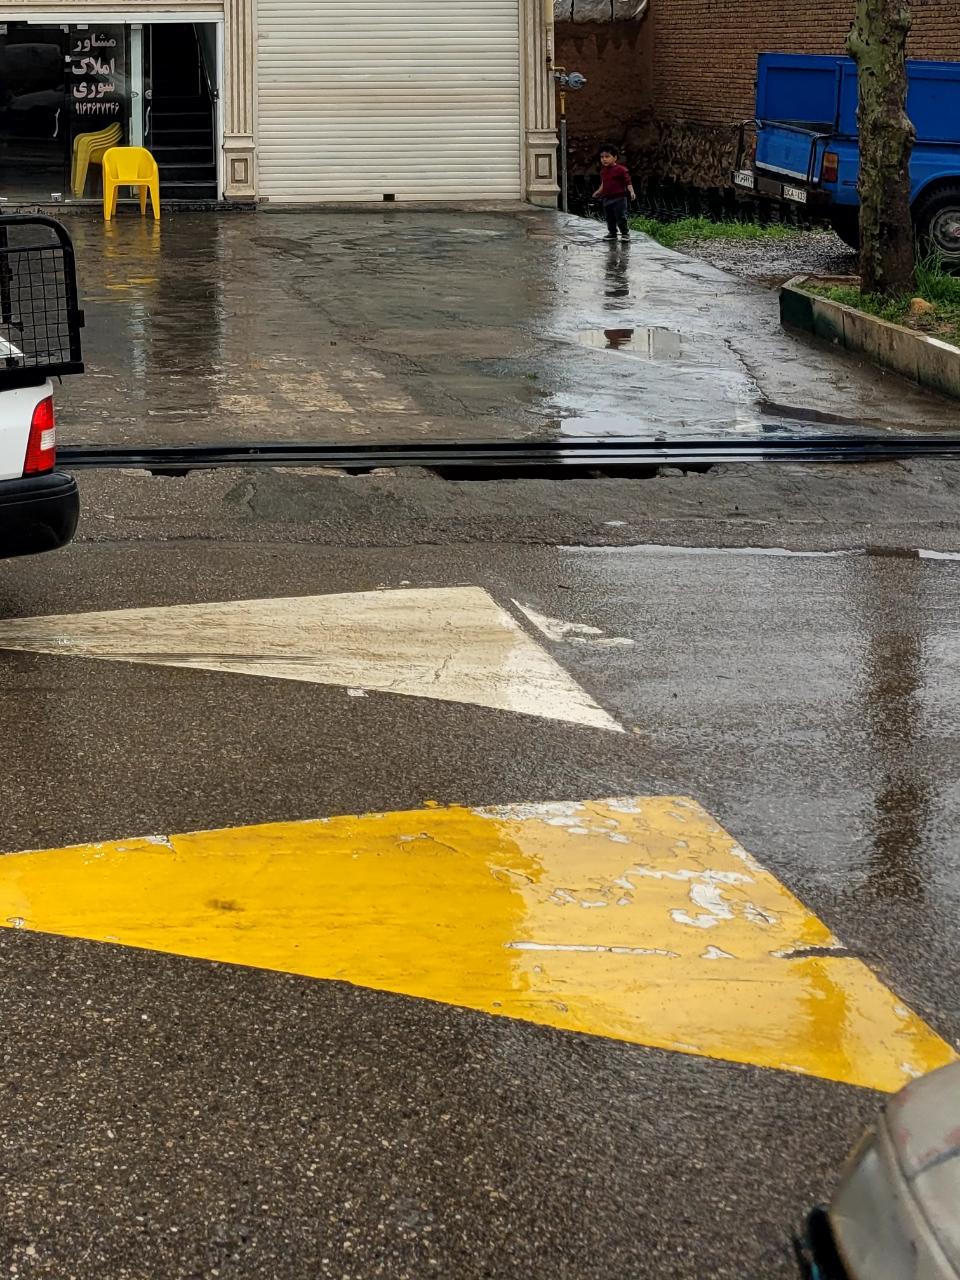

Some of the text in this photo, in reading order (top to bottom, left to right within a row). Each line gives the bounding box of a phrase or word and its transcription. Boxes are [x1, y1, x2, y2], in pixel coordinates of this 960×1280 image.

[72, 33, 117, 52] مشاور
[72, 57, 115, 75] املاک
[73, 81, 115, 98] سوری
